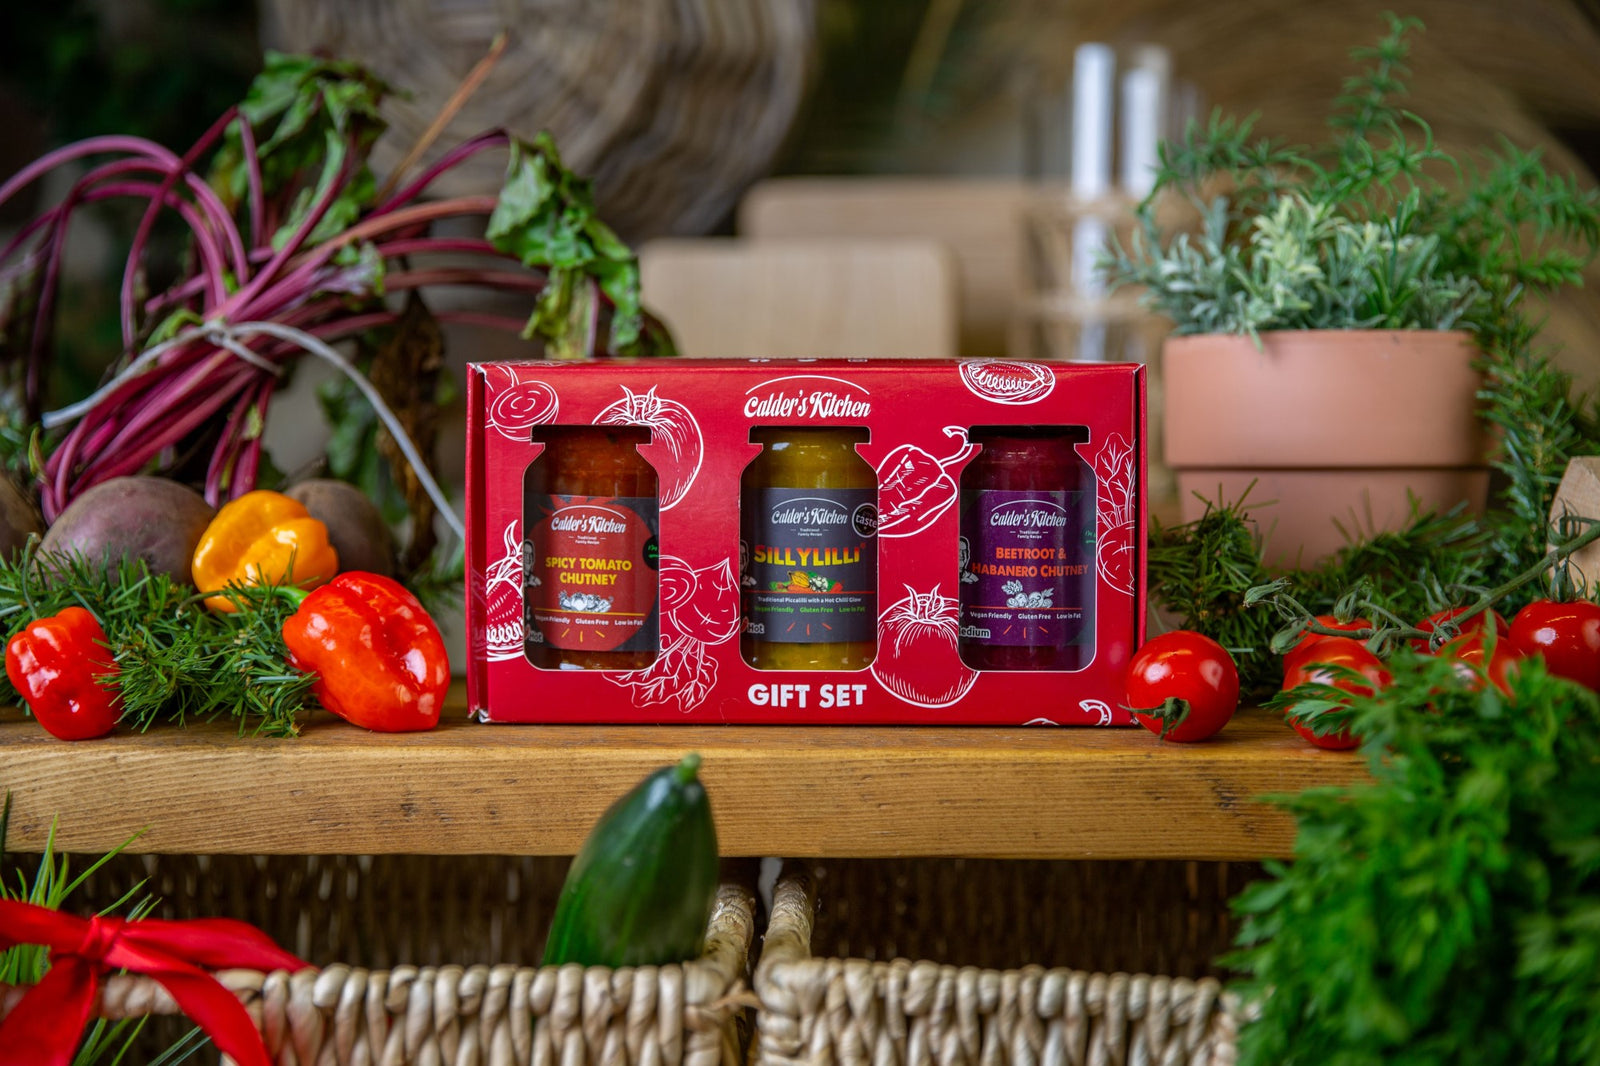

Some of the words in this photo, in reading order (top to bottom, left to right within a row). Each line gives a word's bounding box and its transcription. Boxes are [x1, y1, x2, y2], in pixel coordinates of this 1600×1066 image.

[743, 389, 808, 418] Calder's
[809, 391, 871, 419] Kitchen
[551, 514, 588, 532] Calder's
[588, 516, 627, 533] Kitchen
[772, 507, 810, 524] Calder's
[811, 508, 848, 525] Kitchen
[855, 514, 877, 528] taste
[990, 509, 1030, 527] Calder's
[1031, 510, 1067, 527] Kitchen
[754, 544, 860, 567] SILLYLILLI
[995, 546, 1056, 560] BEETROOT
[1058, 548, 1067, 560] &
[545, 556, 576, 569] SPICY
[579, 558, 632, 572] TOMATO
[971, 562, 1038, 578] HABANERO
[1040, 564, 1089, 578] CHUTNEY
[559, 572, 618, 586] CHUTNEY
[754, 605, 771, 613] Vegan
[771, 606, 794, 614] Friendly
[970, 611, 987, 619] Vegan
[988, 611, 1013, 620] Friendly
[549, 616, 570, 625] Friendly
[748, 622, 765, 634] Hot
[959, 626, 991, 638] edium
[747, 683, 810, 708] GIFT
[819, 683, 867, 708] SET
